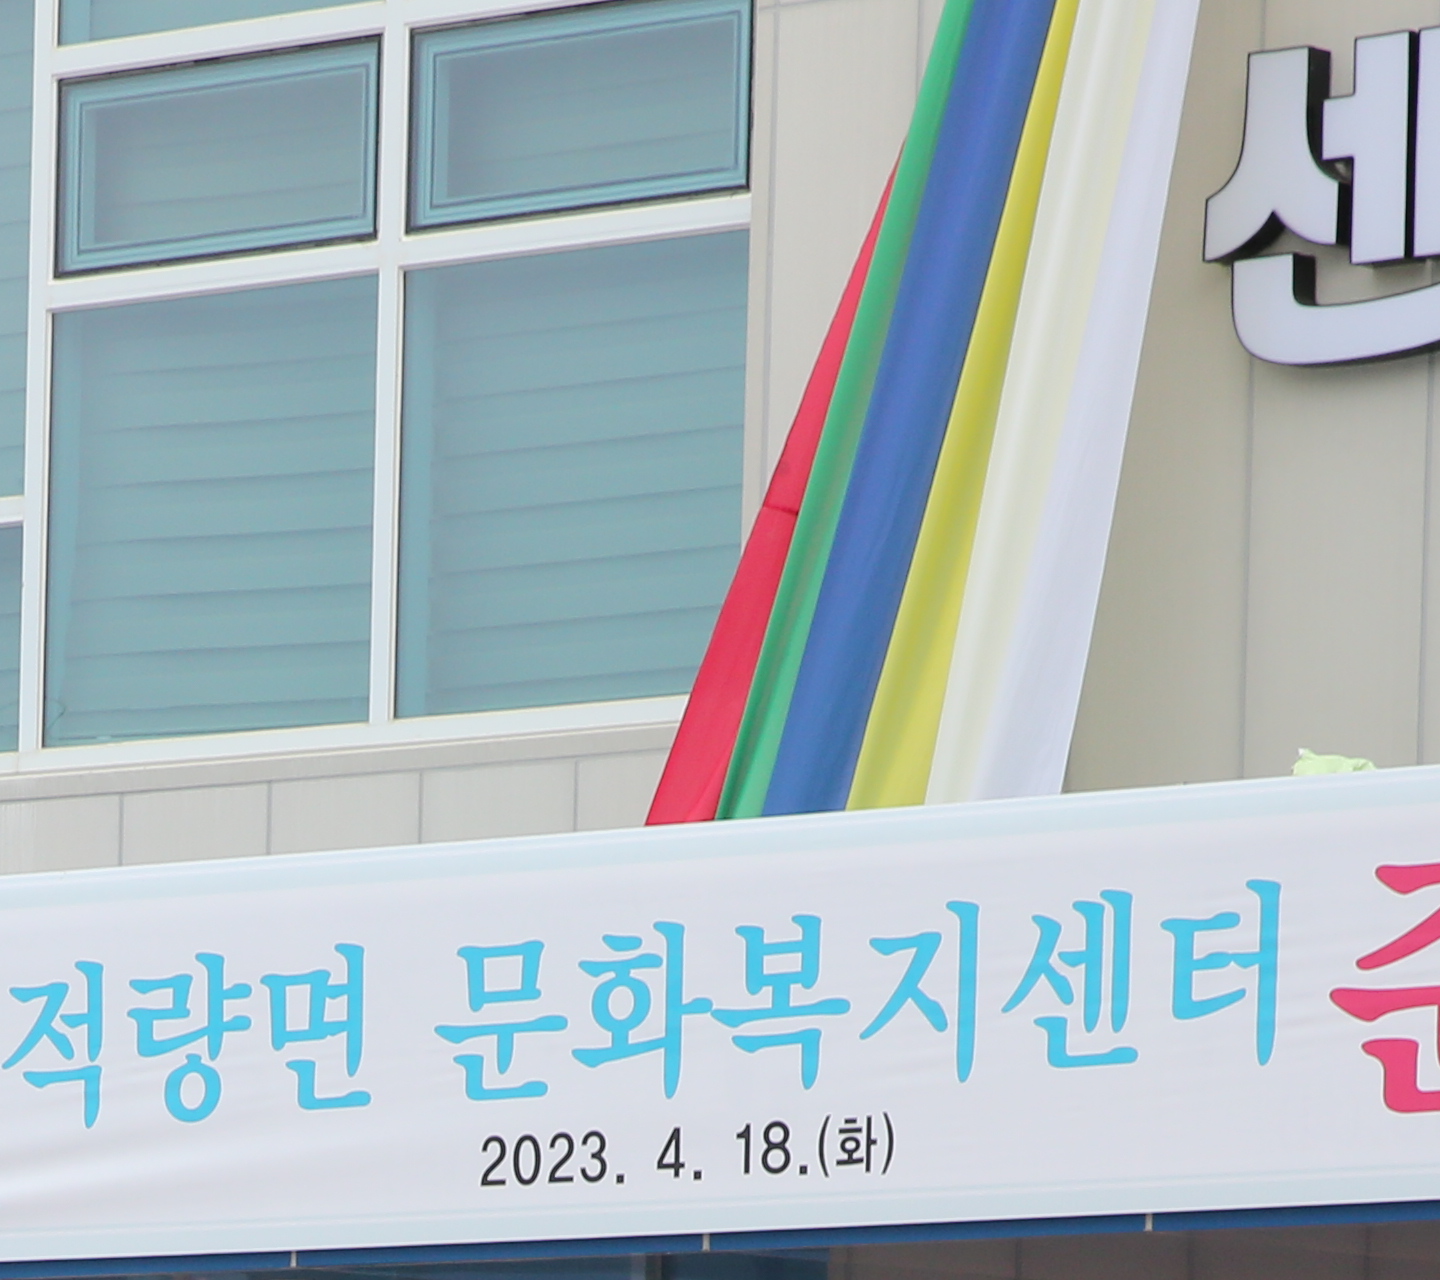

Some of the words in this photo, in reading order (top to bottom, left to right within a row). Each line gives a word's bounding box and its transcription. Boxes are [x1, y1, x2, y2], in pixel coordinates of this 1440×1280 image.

[1, 942, 373, 1129] 적량면
[433, 889, 1282, 1102] 문화복지센터
[479, 1129, 627, 1188] 2023.
[655, 1126, 705, 1182] 4.
[733, 1112, 897, 1179] 18.(화)
